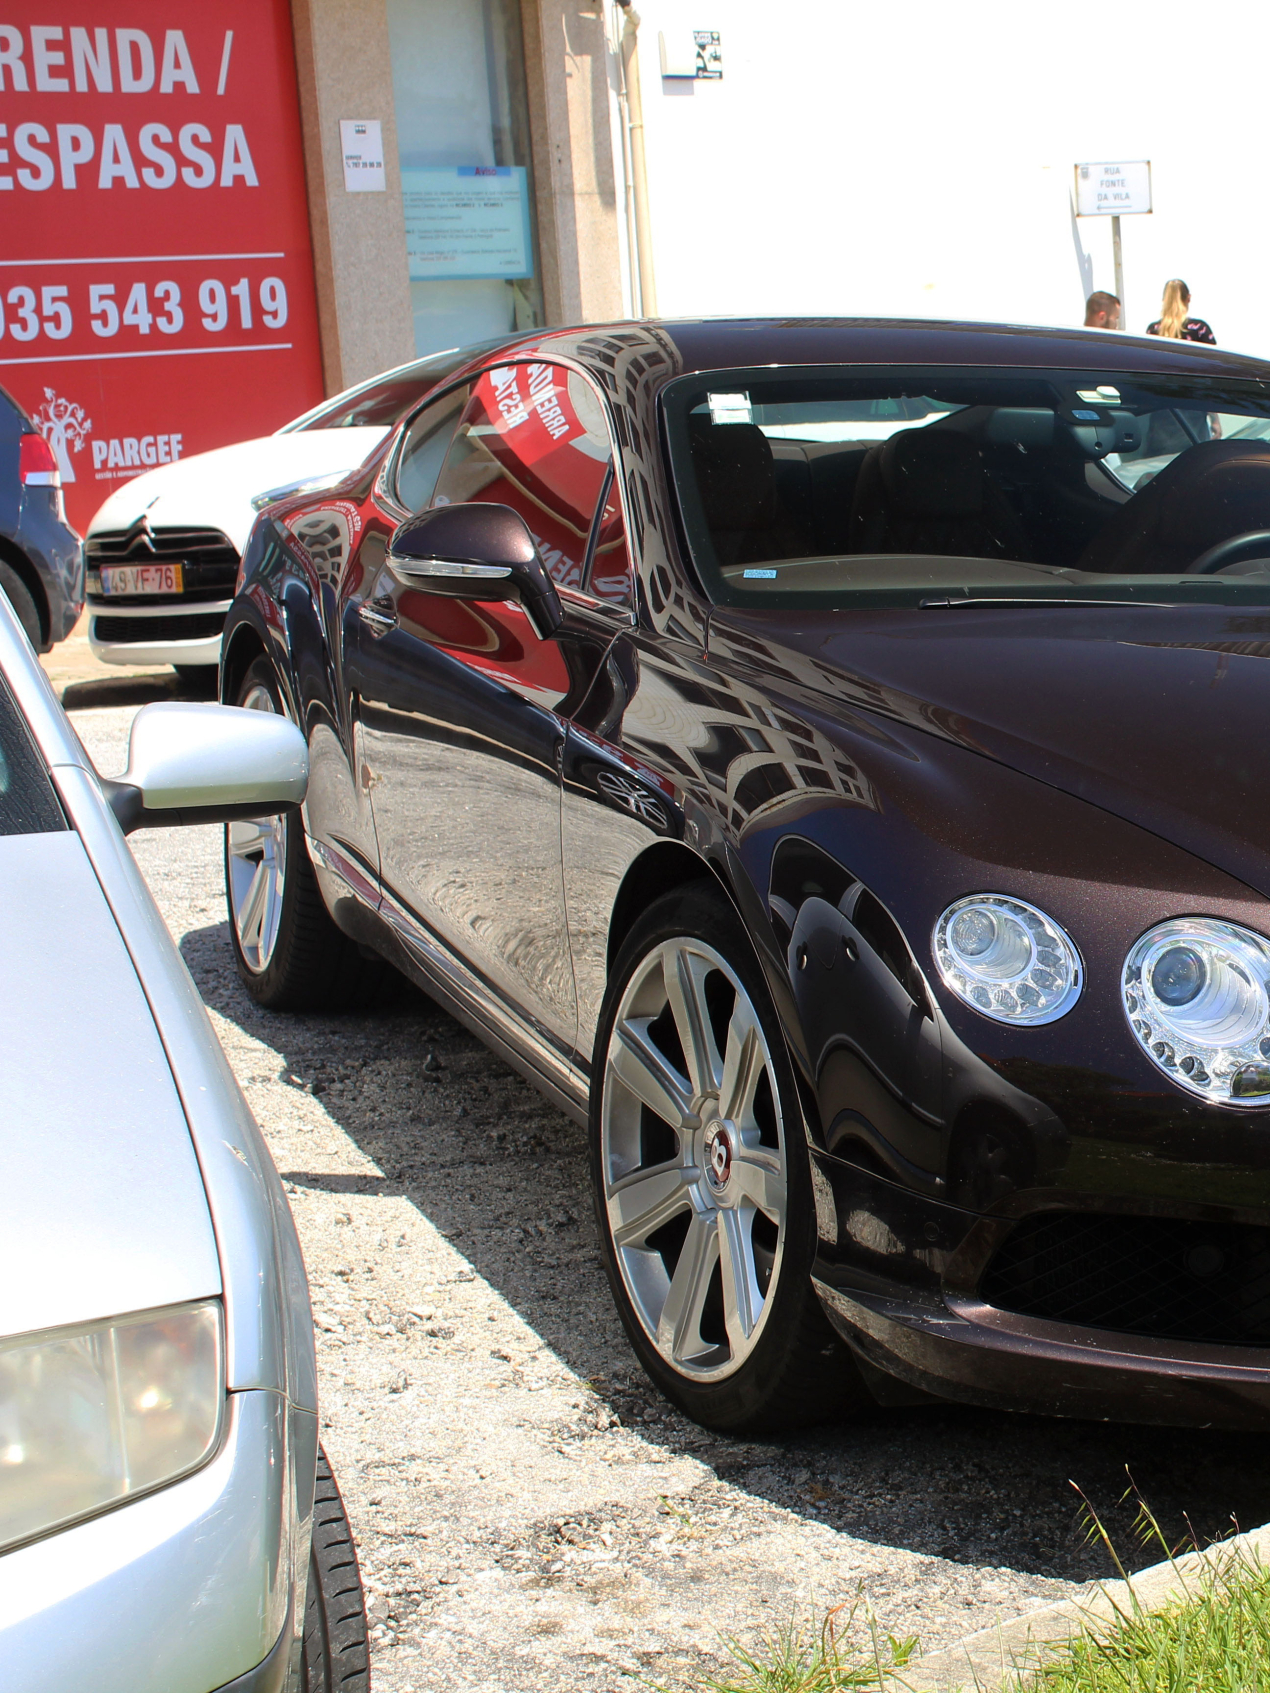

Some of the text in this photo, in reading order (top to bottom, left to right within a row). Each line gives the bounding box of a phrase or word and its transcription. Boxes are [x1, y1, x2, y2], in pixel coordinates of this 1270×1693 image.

[217, 30, 233, 95] /
[475, 166, 497, 176] Aviso
[1104, 167, 1121, 175] RUA
[1100, 179, 1126, 188] FONTE
[1097, 192, 1130, 202] DA VILA
[0, 276, 288, 341] 35 543 919
[91, 433, 182, 469] PARGEF
